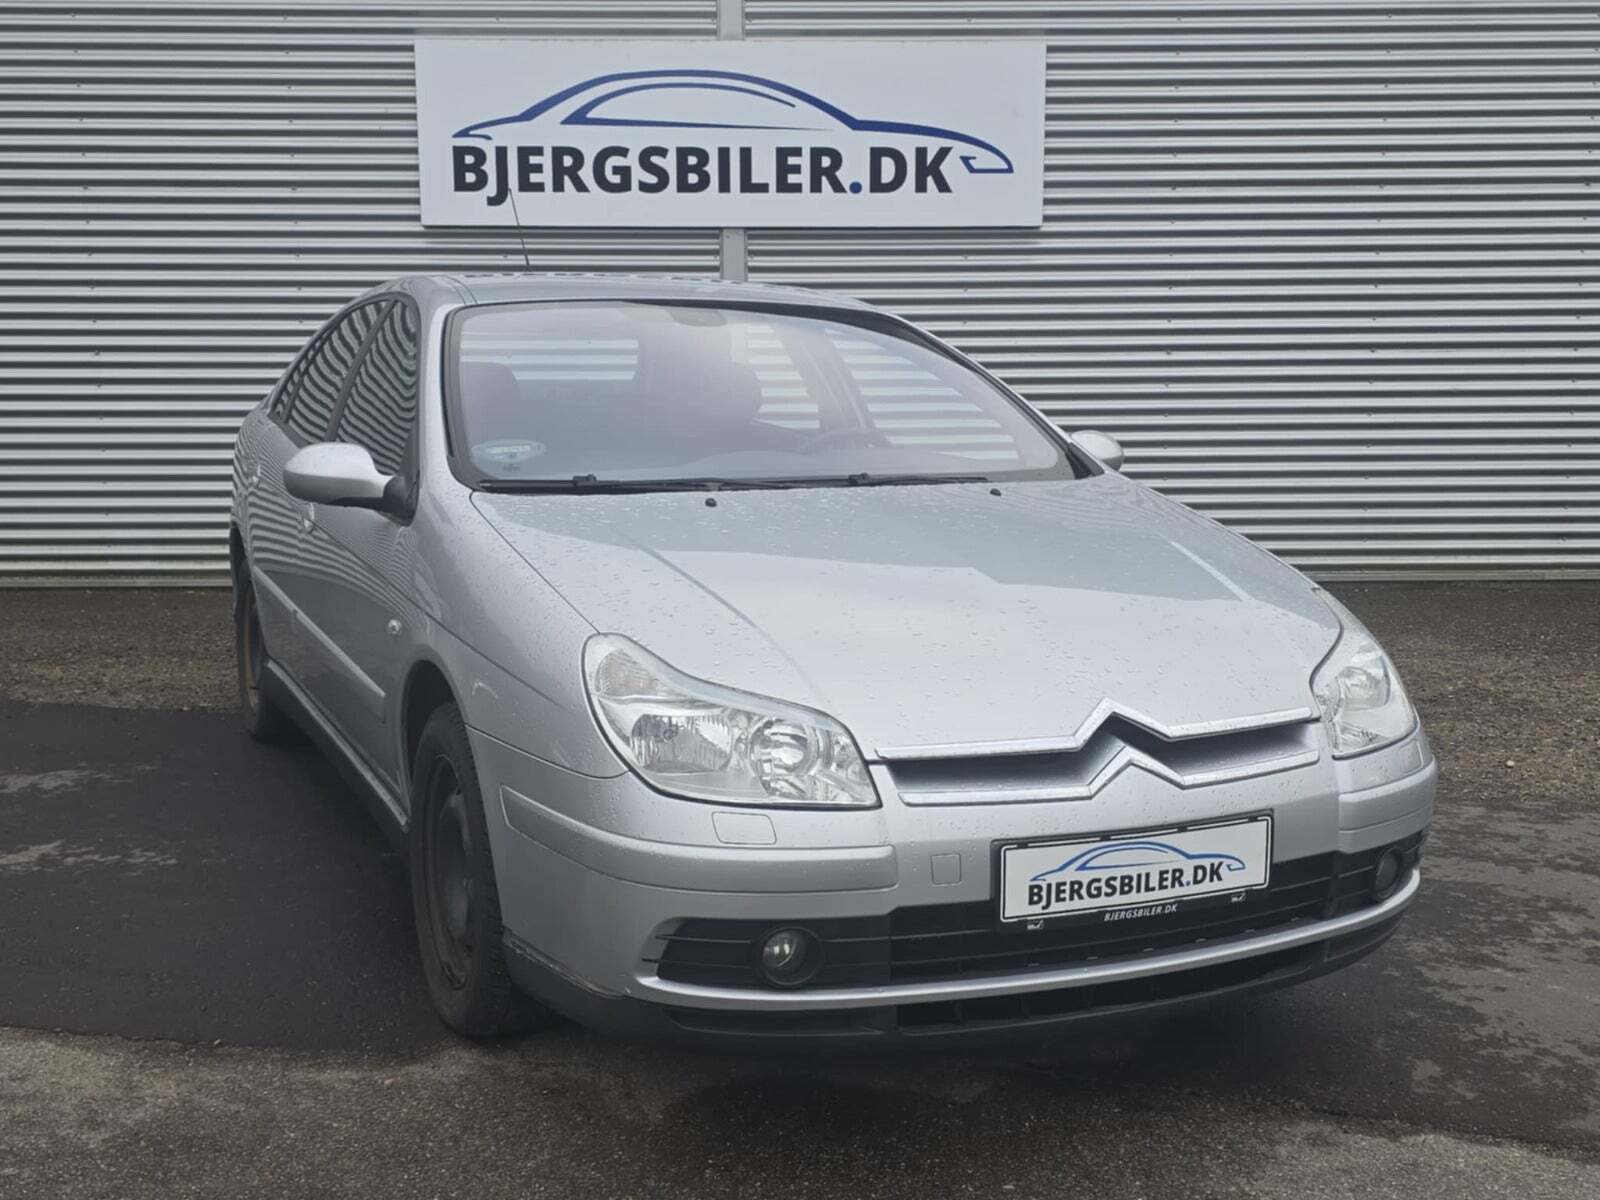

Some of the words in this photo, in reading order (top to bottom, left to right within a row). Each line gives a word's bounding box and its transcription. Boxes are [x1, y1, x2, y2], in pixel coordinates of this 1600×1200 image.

[452, 145, 953, 206] BJERGSBILER.DK
[1028, 861, 1223, 910] BJERGSBILER.DK
[1103, 904, 1178, 922] BJERGSBILER.DK
